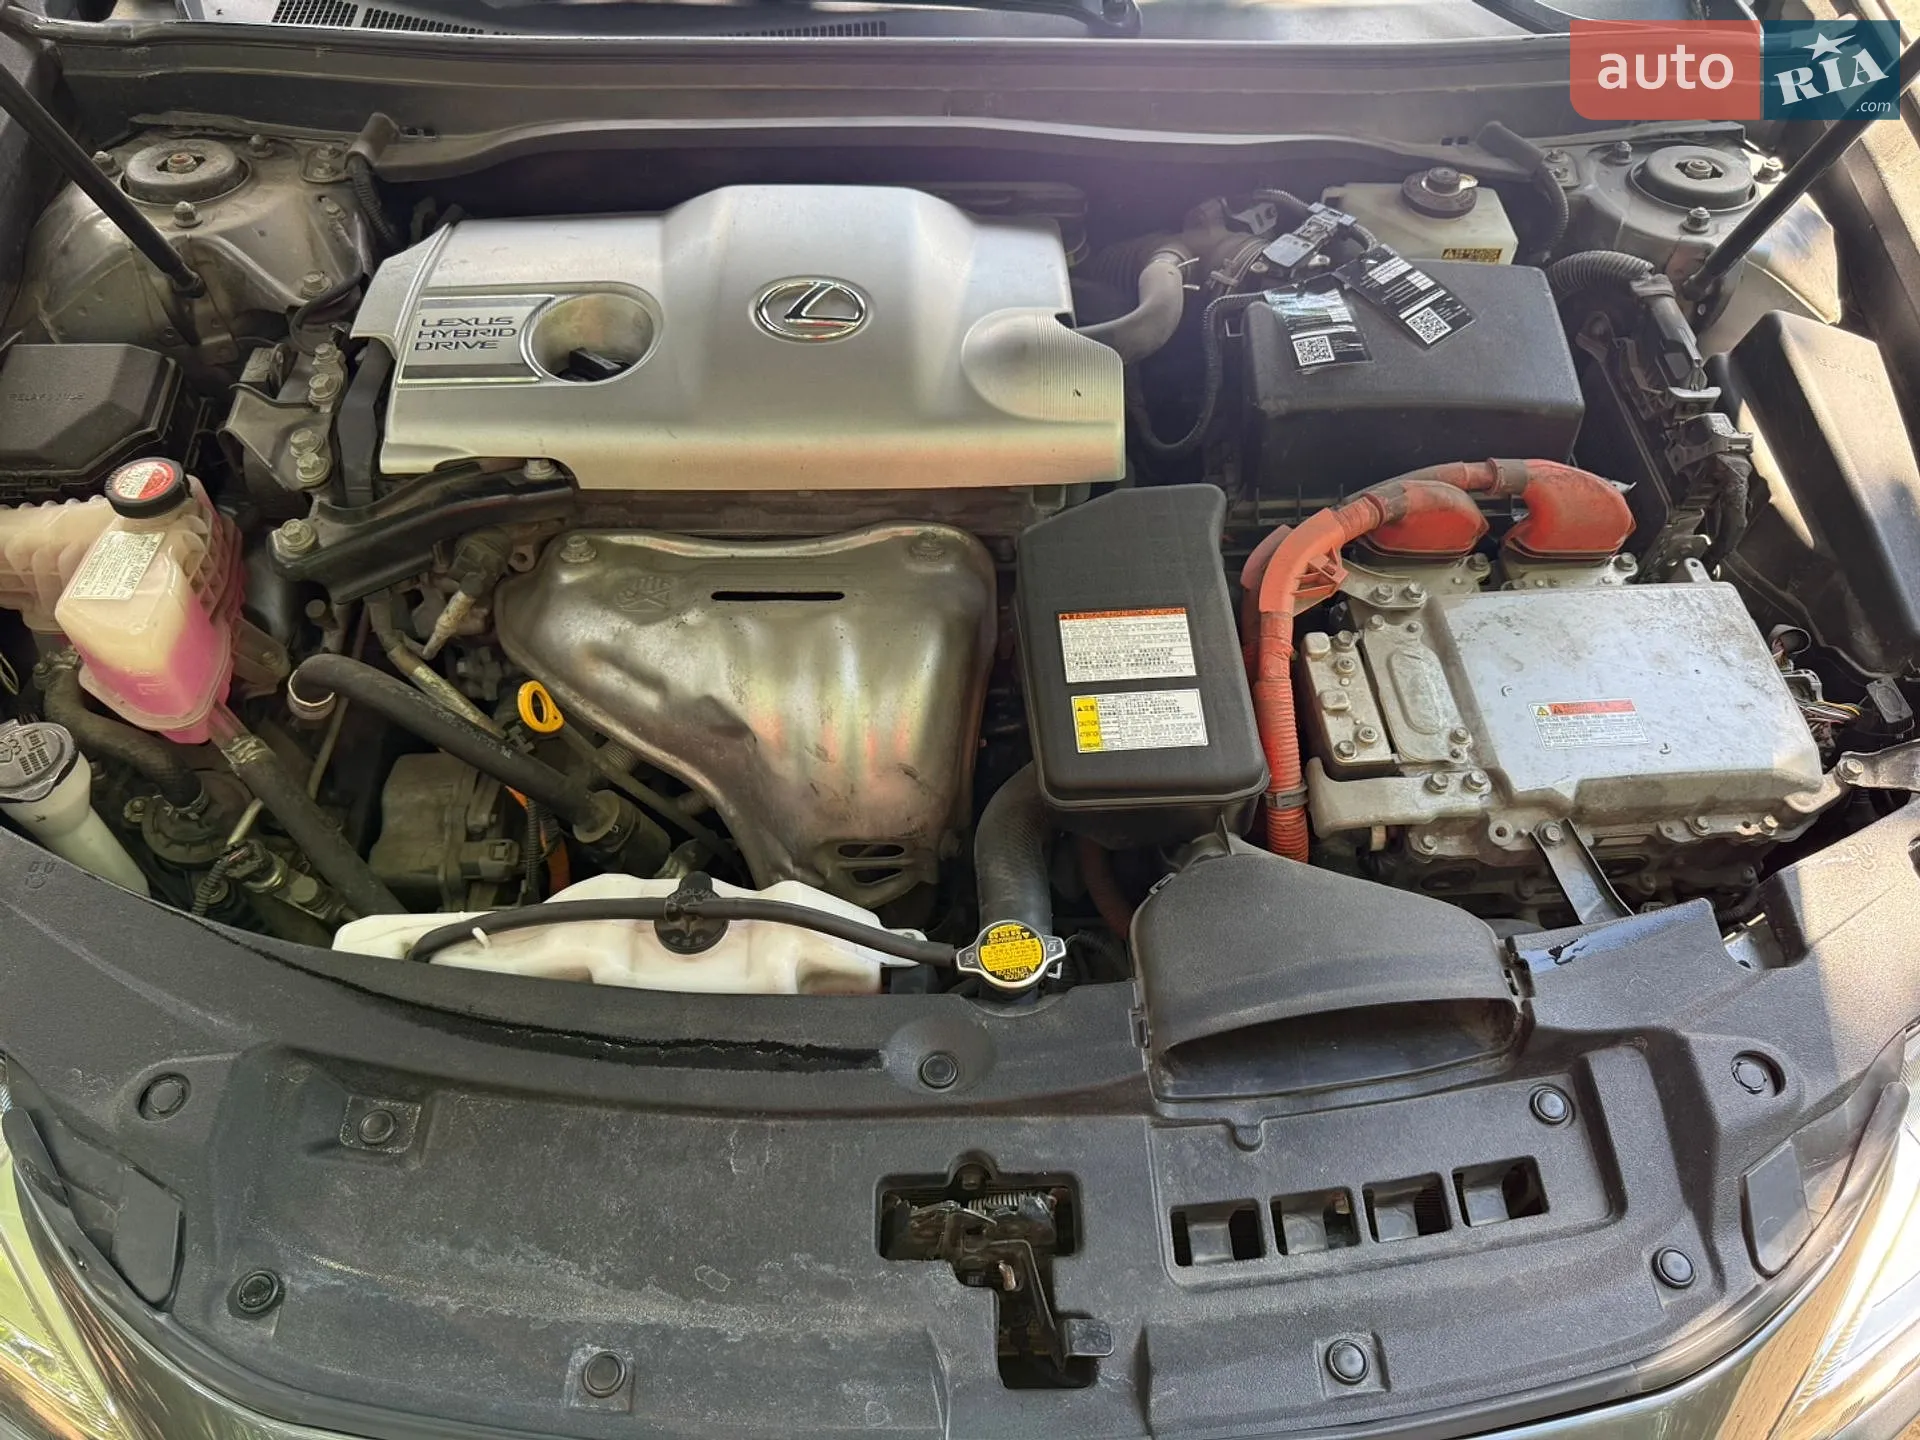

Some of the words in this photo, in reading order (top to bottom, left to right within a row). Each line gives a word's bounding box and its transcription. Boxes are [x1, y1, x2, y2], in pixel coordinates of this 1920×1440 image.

[421, 316, 514, 328] LEXUS
[417, 327, 518, 339] HYBRID
[414, 340, 501, 351] DRIVE
